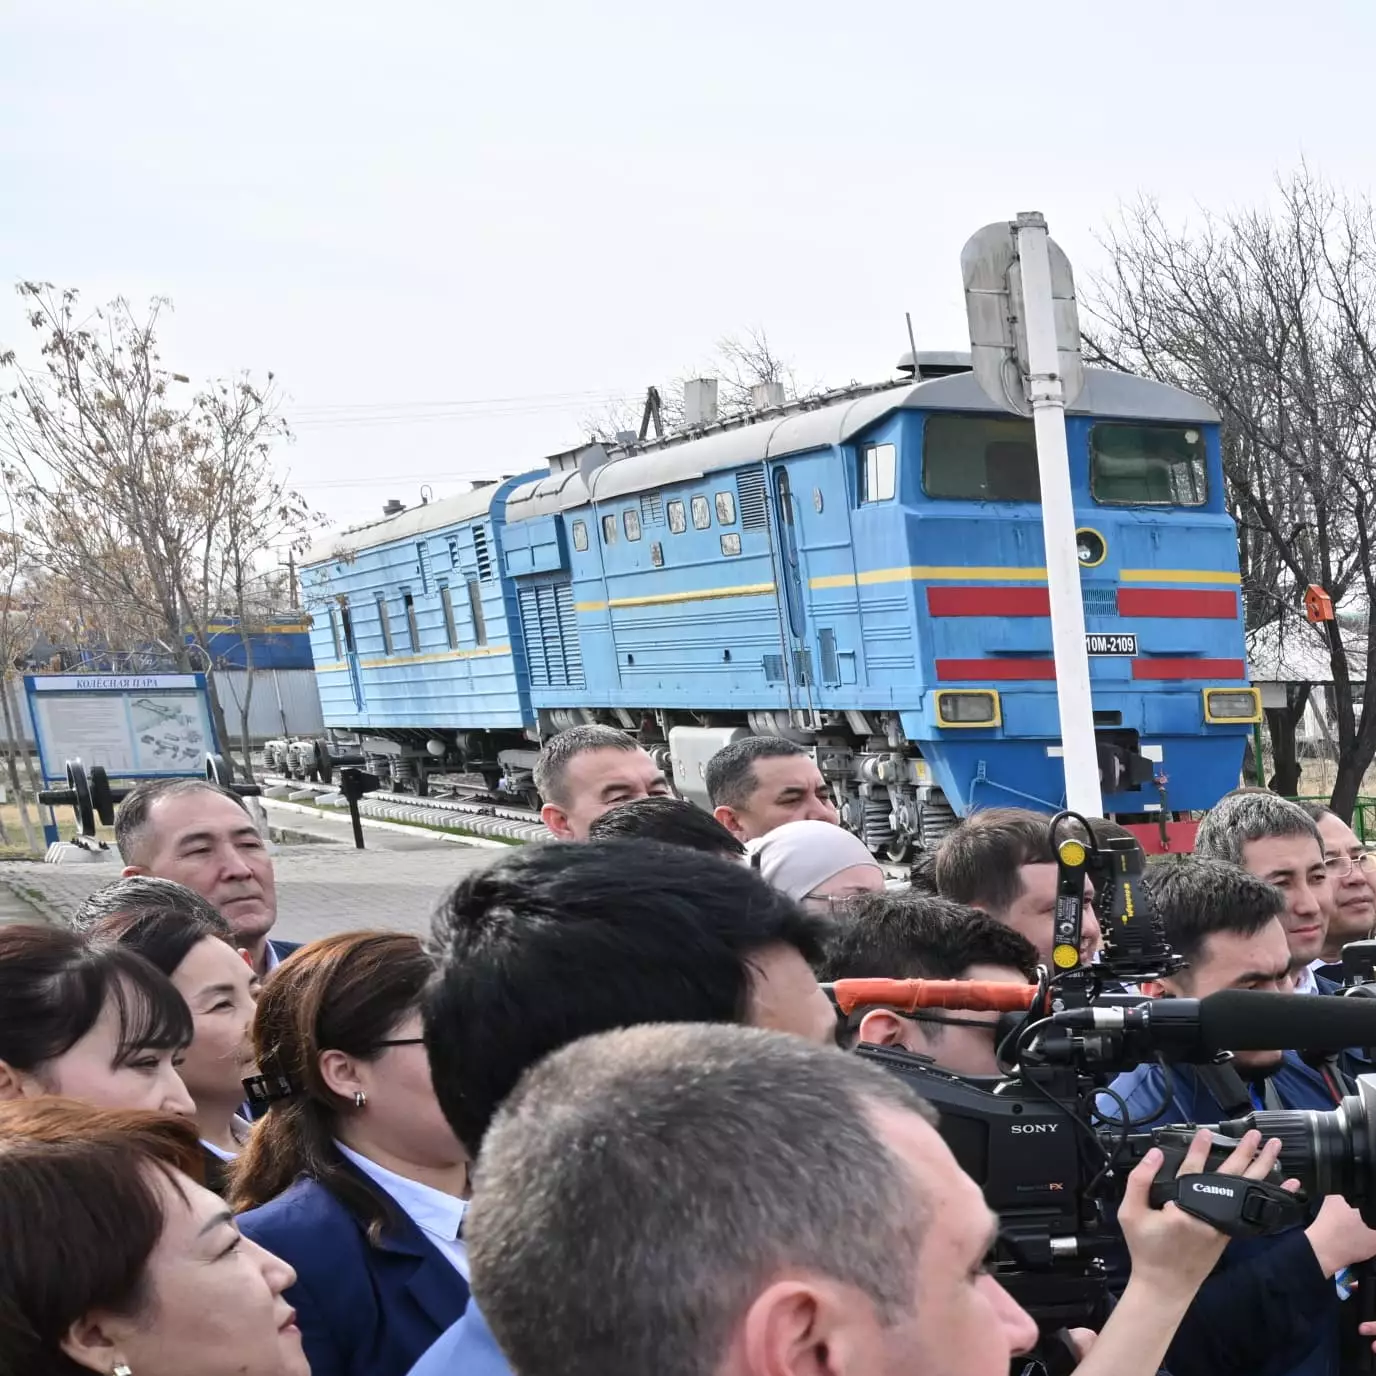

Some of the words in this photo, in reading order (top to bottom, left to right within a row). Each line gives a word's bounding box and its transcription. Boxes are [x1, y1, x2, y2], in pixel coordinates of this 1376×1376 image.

[133, 678, 158, 687] ПАРА
[1011, 1123, 1058, 1134] SONY
[1192, 1183, 1234, 1197] Canon
